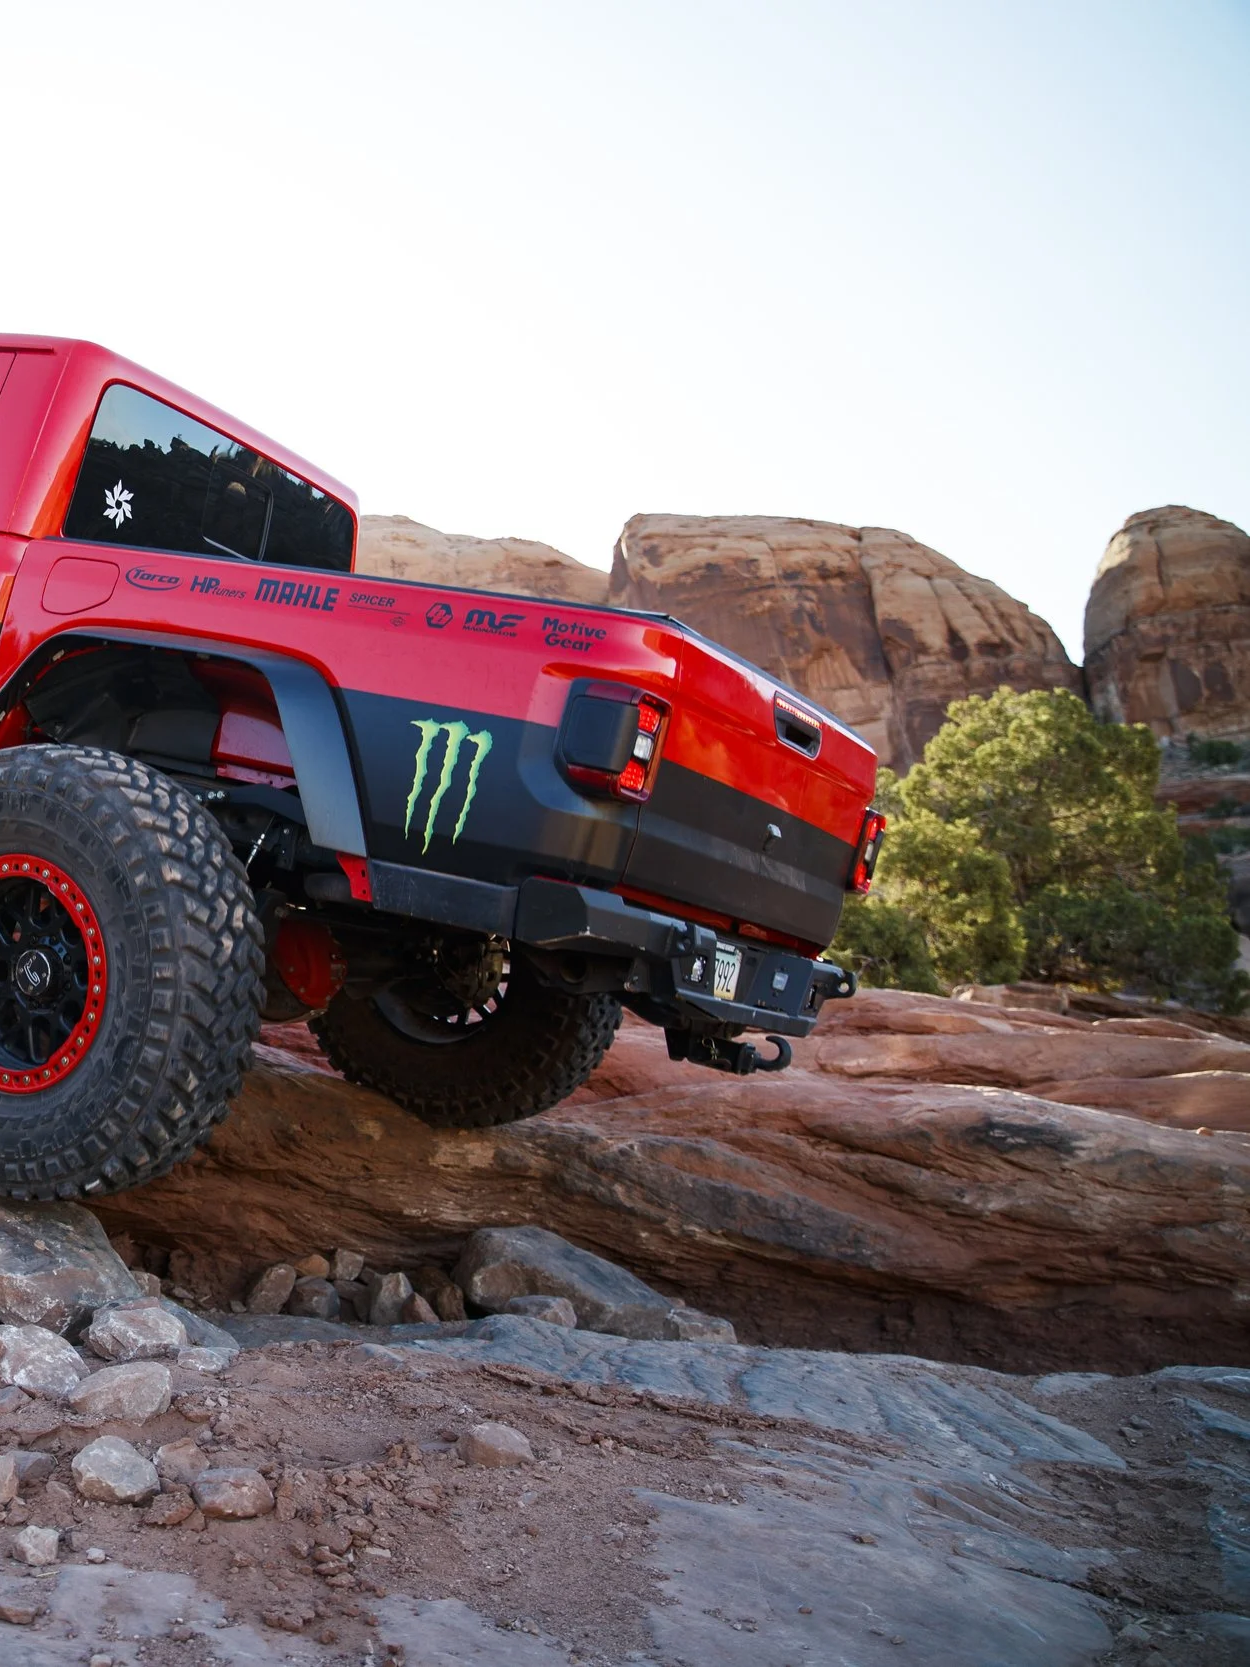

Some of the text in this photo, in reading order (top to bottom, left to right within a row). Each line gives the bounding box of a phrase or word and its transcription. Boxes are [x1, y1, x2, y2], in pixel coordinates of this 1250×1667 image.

[134, 568, 181, 585] Torco
[254, 578, 340, 612] MAHLE
[349, 592, 395, 608] SPICER
[542, 616, 607, 640] Motive
[545, 633, 593, 652] Gear
